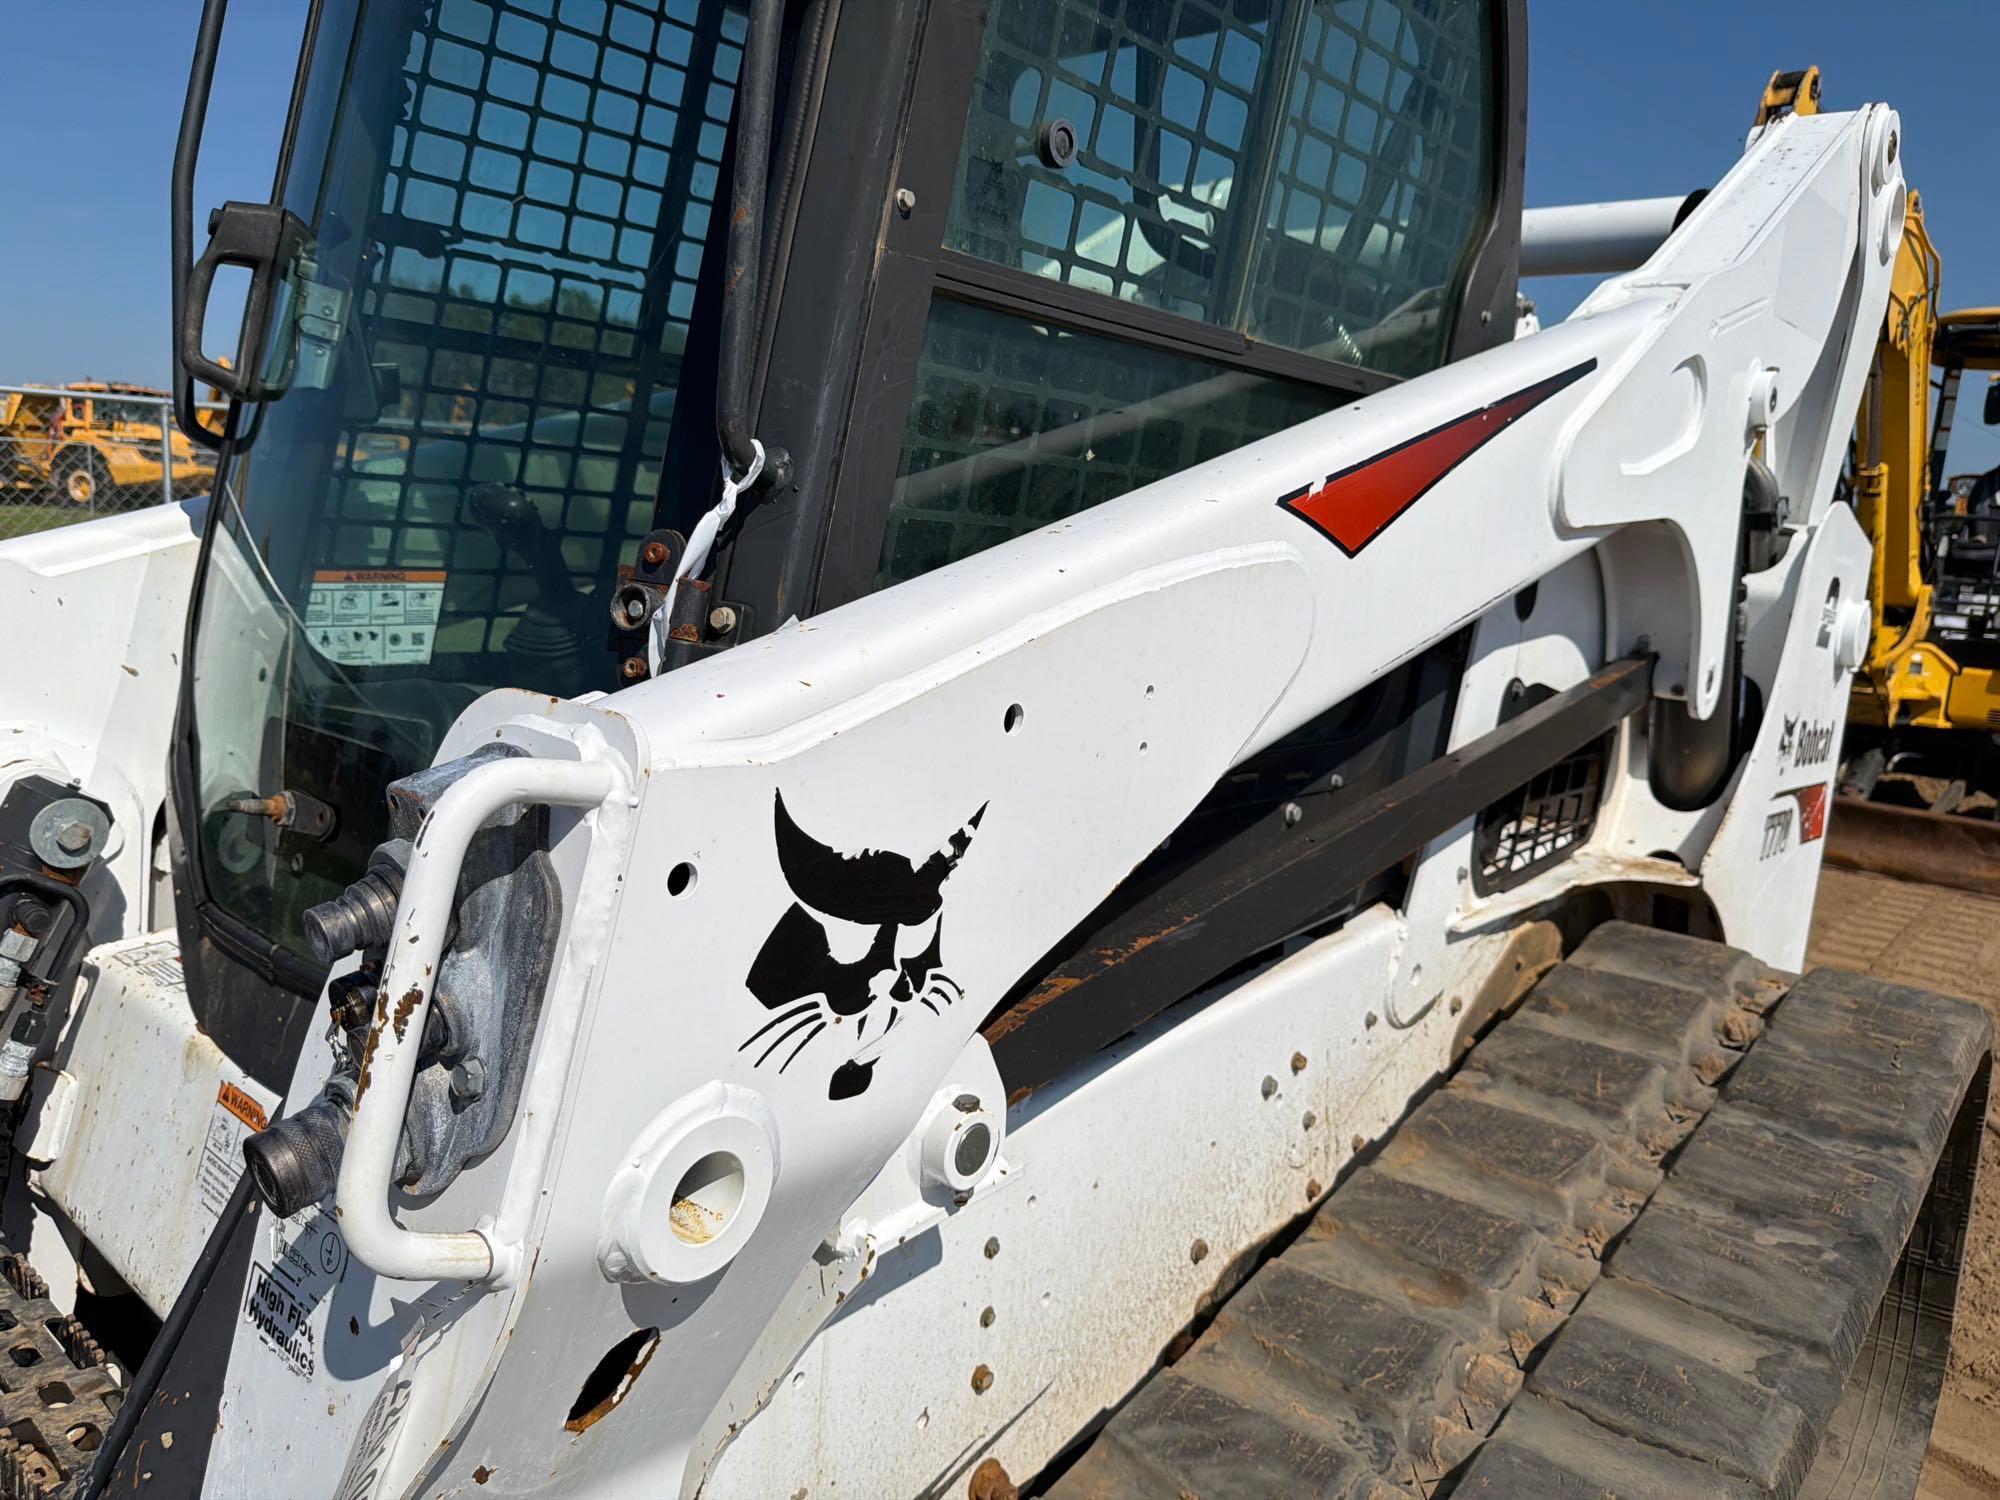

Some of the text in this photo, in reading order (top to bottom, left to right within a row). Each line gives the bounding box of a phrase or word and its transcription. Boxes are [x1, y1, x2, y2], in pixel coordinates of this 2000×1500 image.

[355, 571, 406, 582] WARNING
[1793, 720, 1835, 768] Bobcat
[230, 1093, 268, 1129] WARNING
[256, 1274, 285, 1317] High
[249, 1297, 314, 1377] Hydraulics
